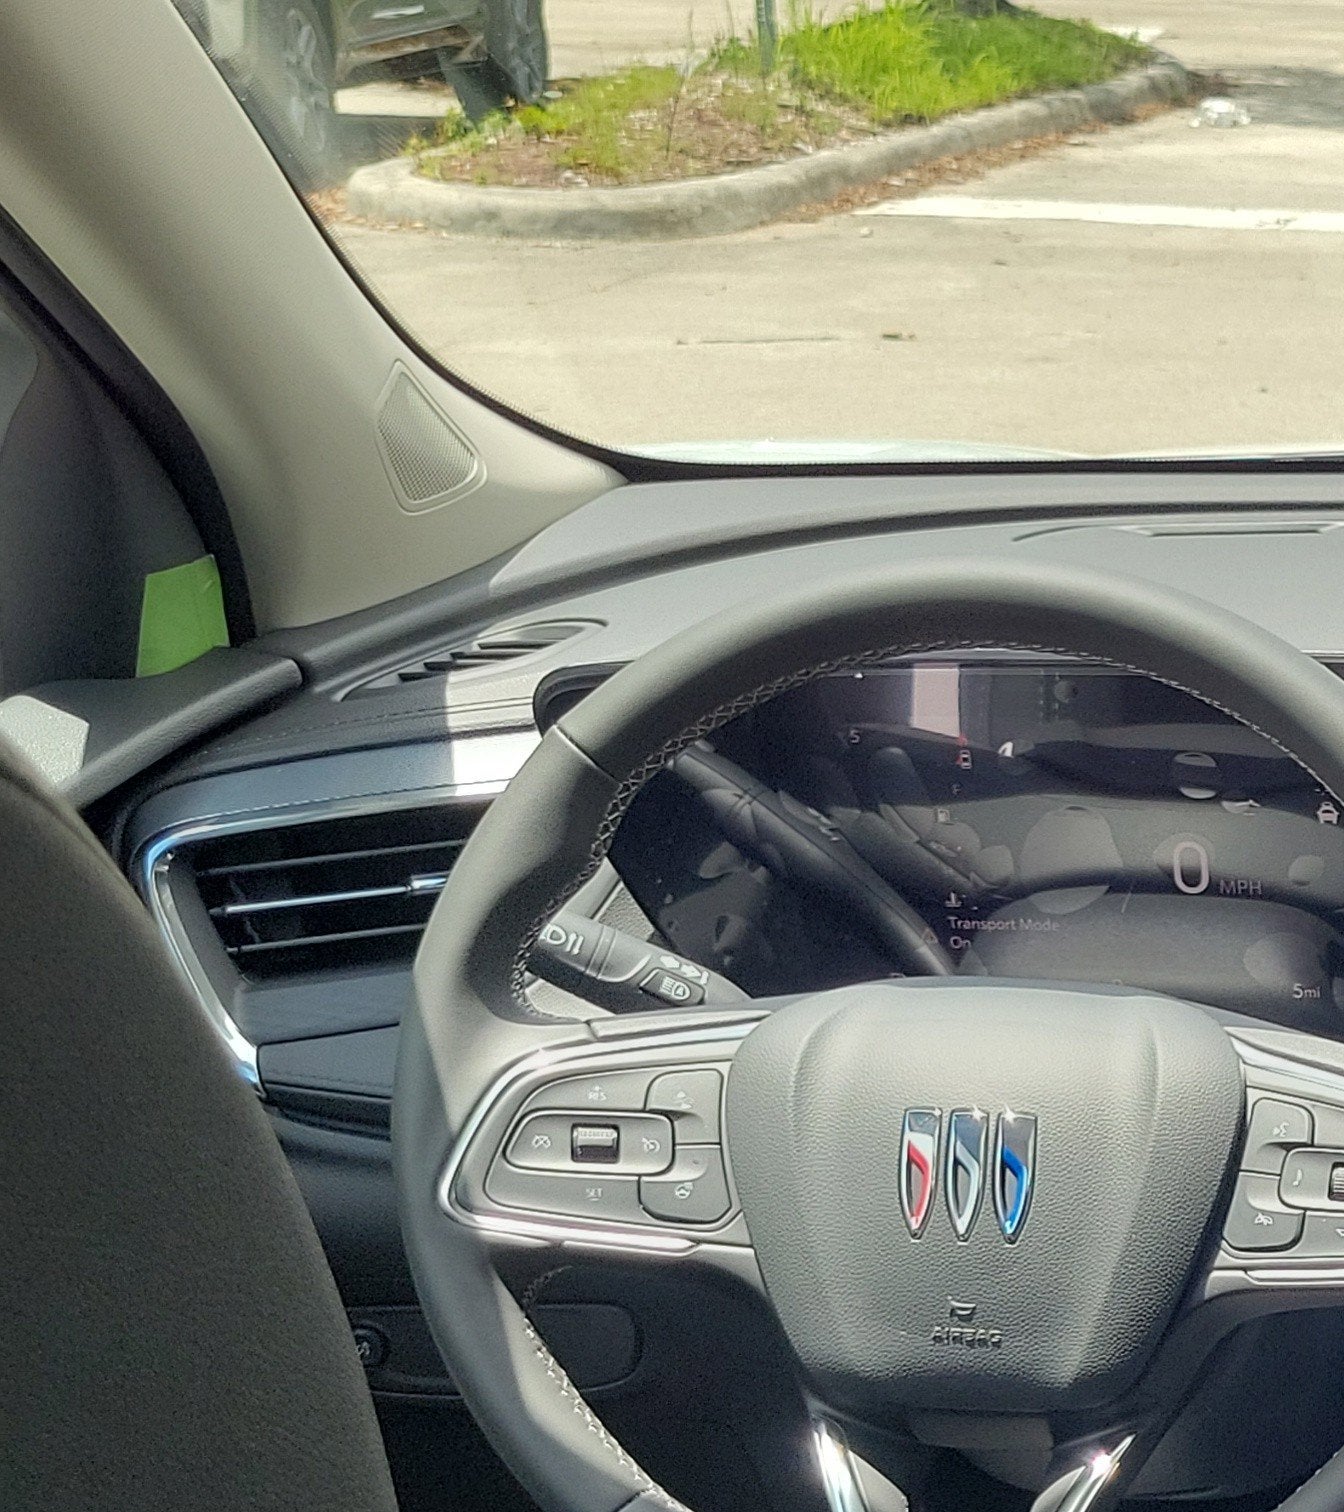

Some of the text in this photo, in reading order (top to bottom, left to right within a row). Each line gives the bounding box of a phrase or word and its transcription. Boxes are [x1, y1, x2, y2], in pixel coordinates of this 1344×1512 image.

[1173, 840, 1263, 896] 0 MPH
[948, 915, 1061, 932] Transport Mode
[949, 935, 972, 950] On
[933, 1326, 1002, 1347] AIRBAG
